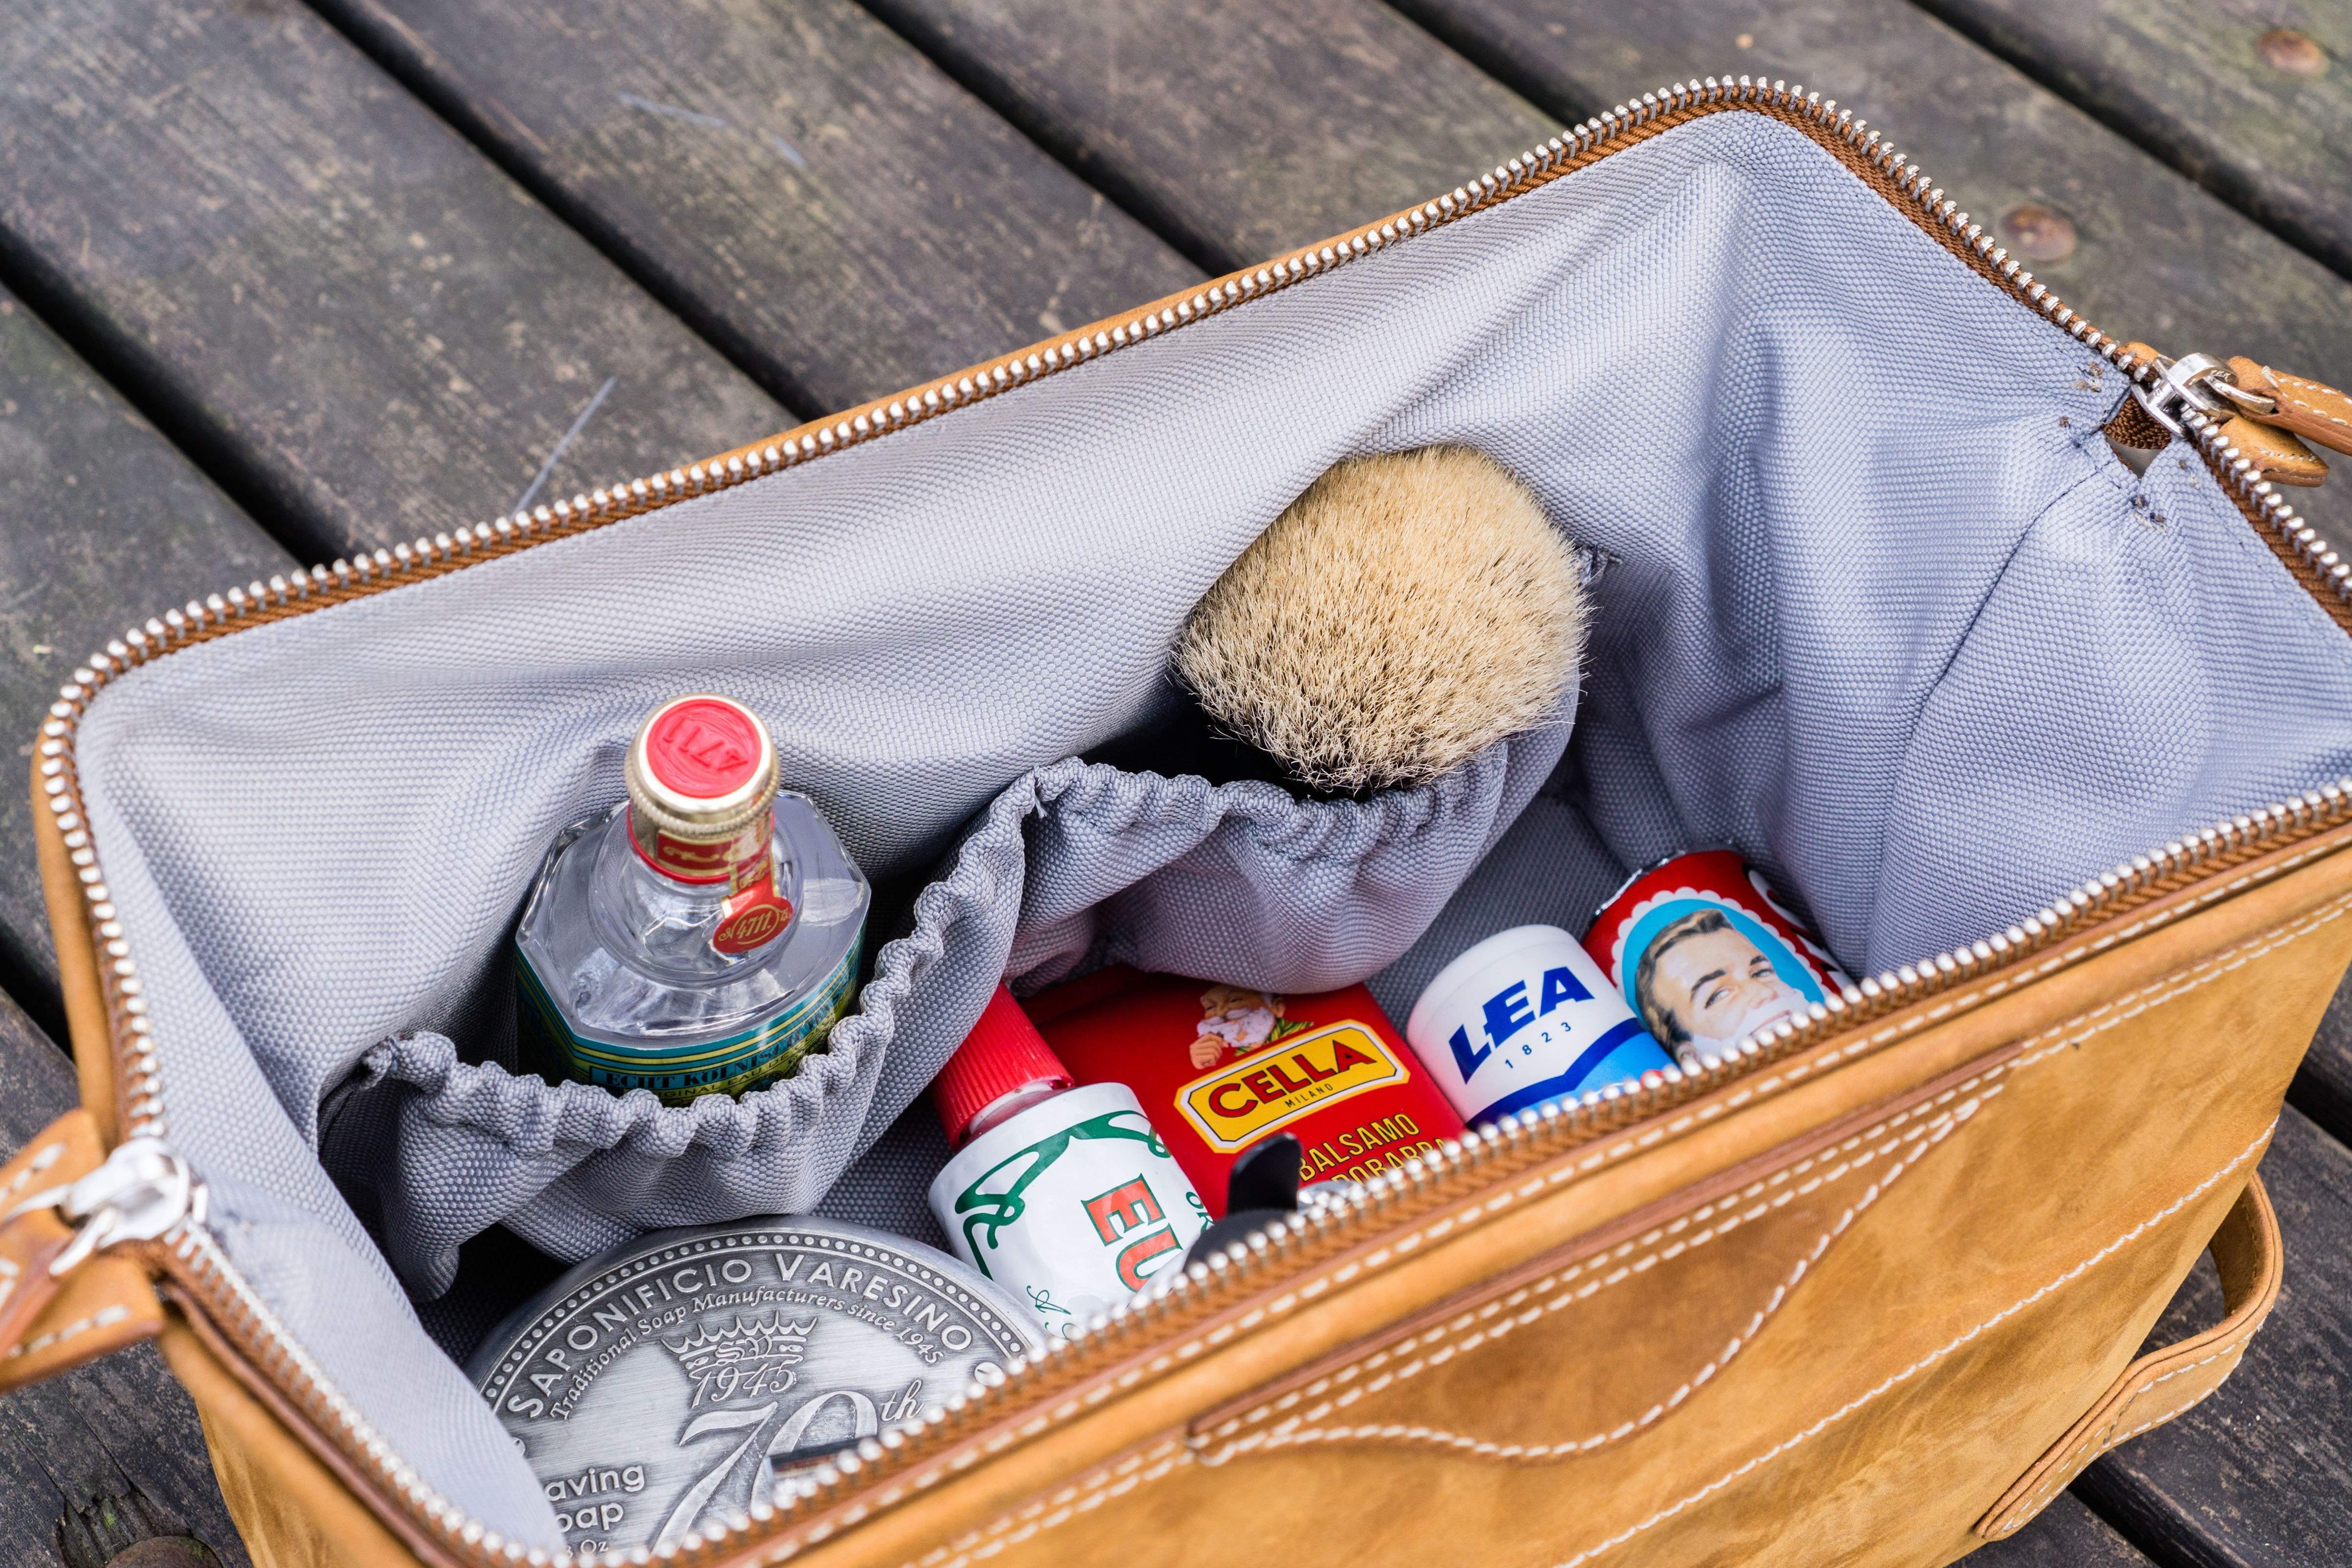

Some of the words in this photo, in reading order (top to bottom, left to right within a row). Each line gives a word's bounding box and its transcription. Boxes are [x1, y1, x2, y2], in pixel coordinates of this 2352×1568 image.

[1448, 966, 1595, 1085] LEA
[606, 1072, 675, 1089] ECHT
[658, 1084, 721, 1099] IGINAL
[728, 1067, 761, 1085] EAU
[769, 1053, 789, 1068] DE
[1208, 1039, 1378, 1119] CELLA
[1284, 1083, 1334, 1108] MILANO
[1298, 1113, 1421, 1182] BALSAMO
[507, 1258, 752, 1418] SAPONIFICIO
[774, 1252, 973, 1351] VARESINO
[549, 1327, 637, 1421] Traditional
[637, 1305, 686, 1336] Soap
[691, 1285, 846, 1314] Manufacturers
[846, 1303, 896, 1331] since
[895, 1326, 944, 1364] 1945
[691, 1362, 798, 1409] 1945
[544, 1465, 645, 1501] aving
[556, 1502, 624, 1533] oap
